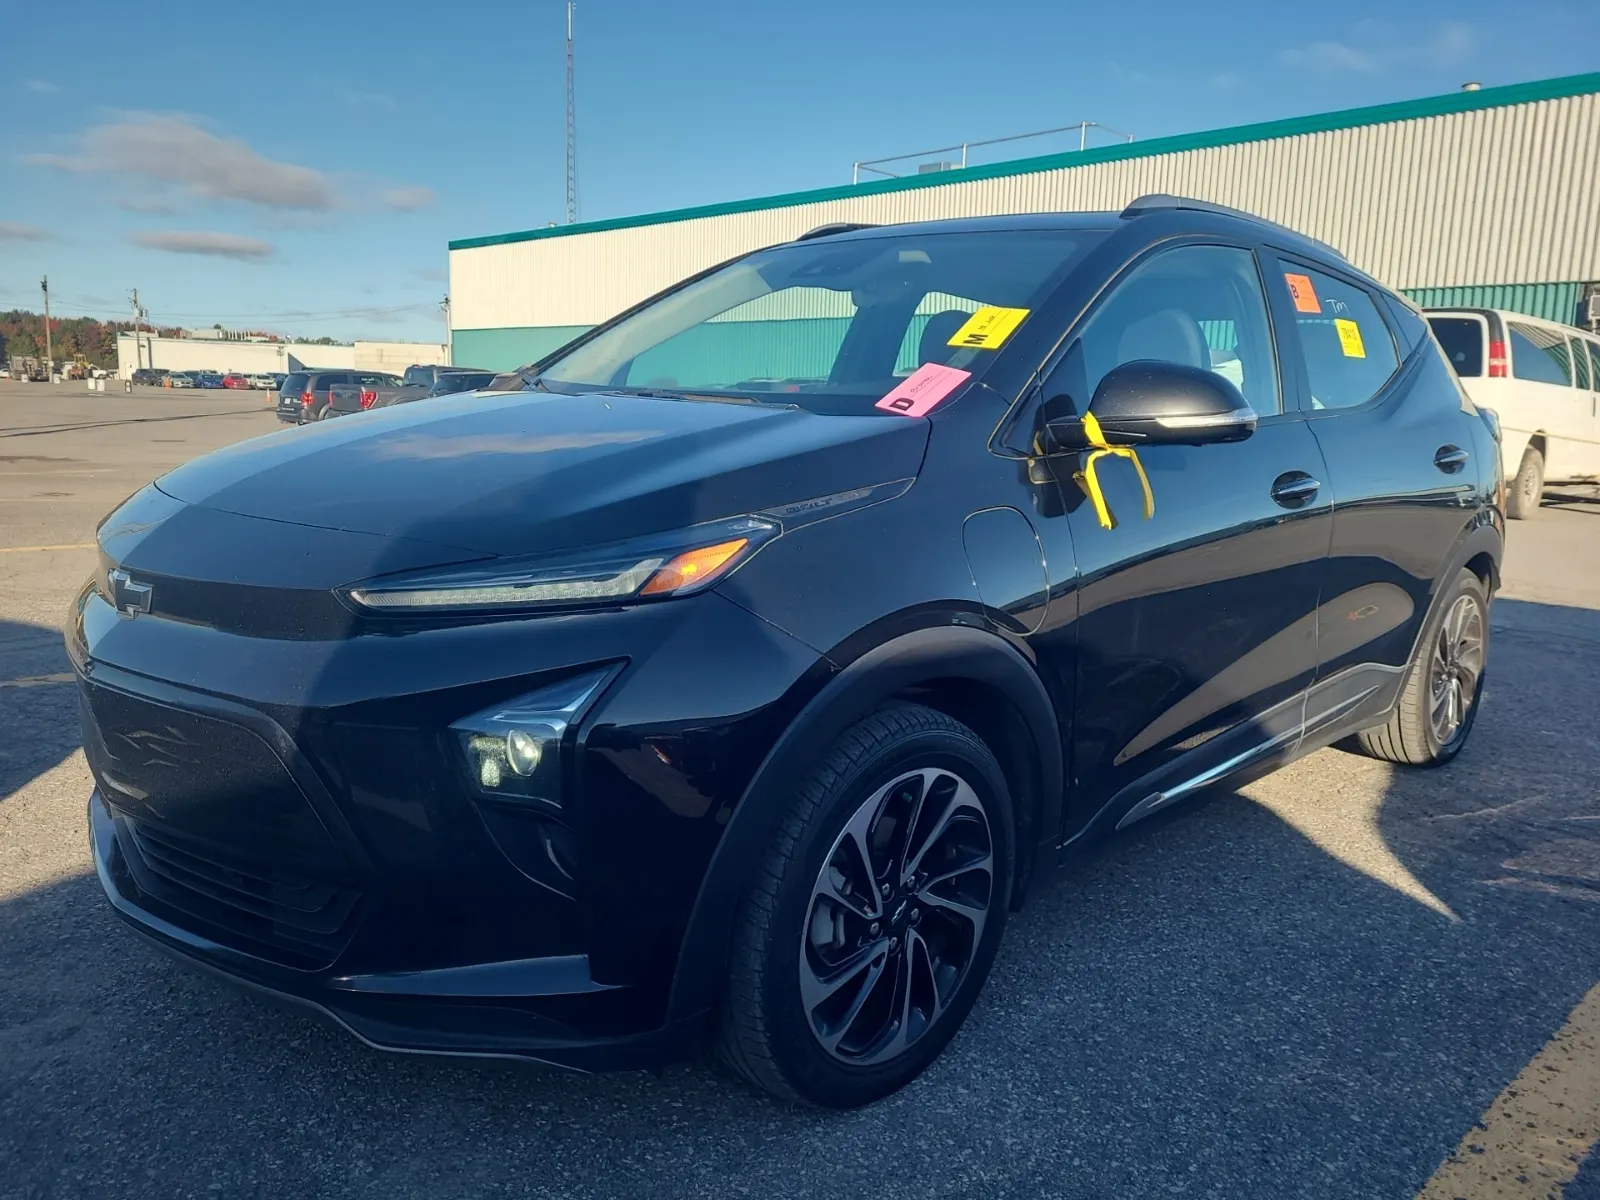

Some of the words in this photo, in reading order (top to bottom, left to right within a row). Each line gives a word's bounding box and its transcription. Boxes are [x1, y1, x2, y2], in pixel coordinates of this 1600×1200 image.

[1290, 284, 1299, 298] B
[963, 333, 988, 345] M
[890, 397, 915, 412] D
